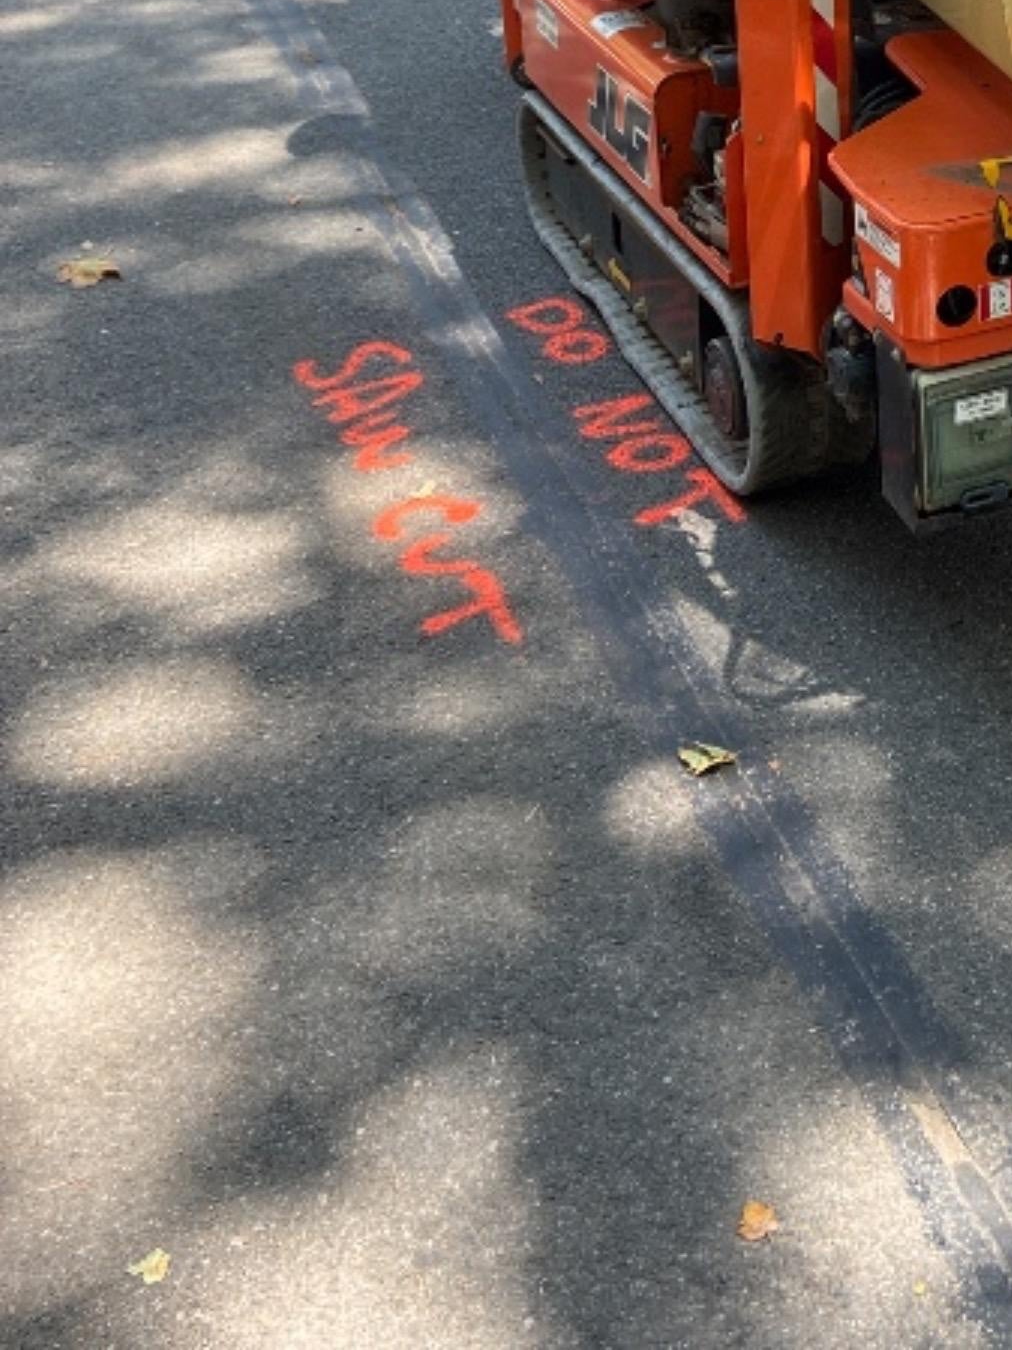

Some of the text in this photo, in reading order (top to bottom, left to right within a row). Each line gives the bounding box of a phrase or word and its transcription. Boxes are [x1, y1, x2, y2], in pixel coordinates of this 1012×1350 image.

[587, 63, 653, 181] JLG
[505, 296, 747, 525] DO NOT
[373, 495, 523, 644] CUT
